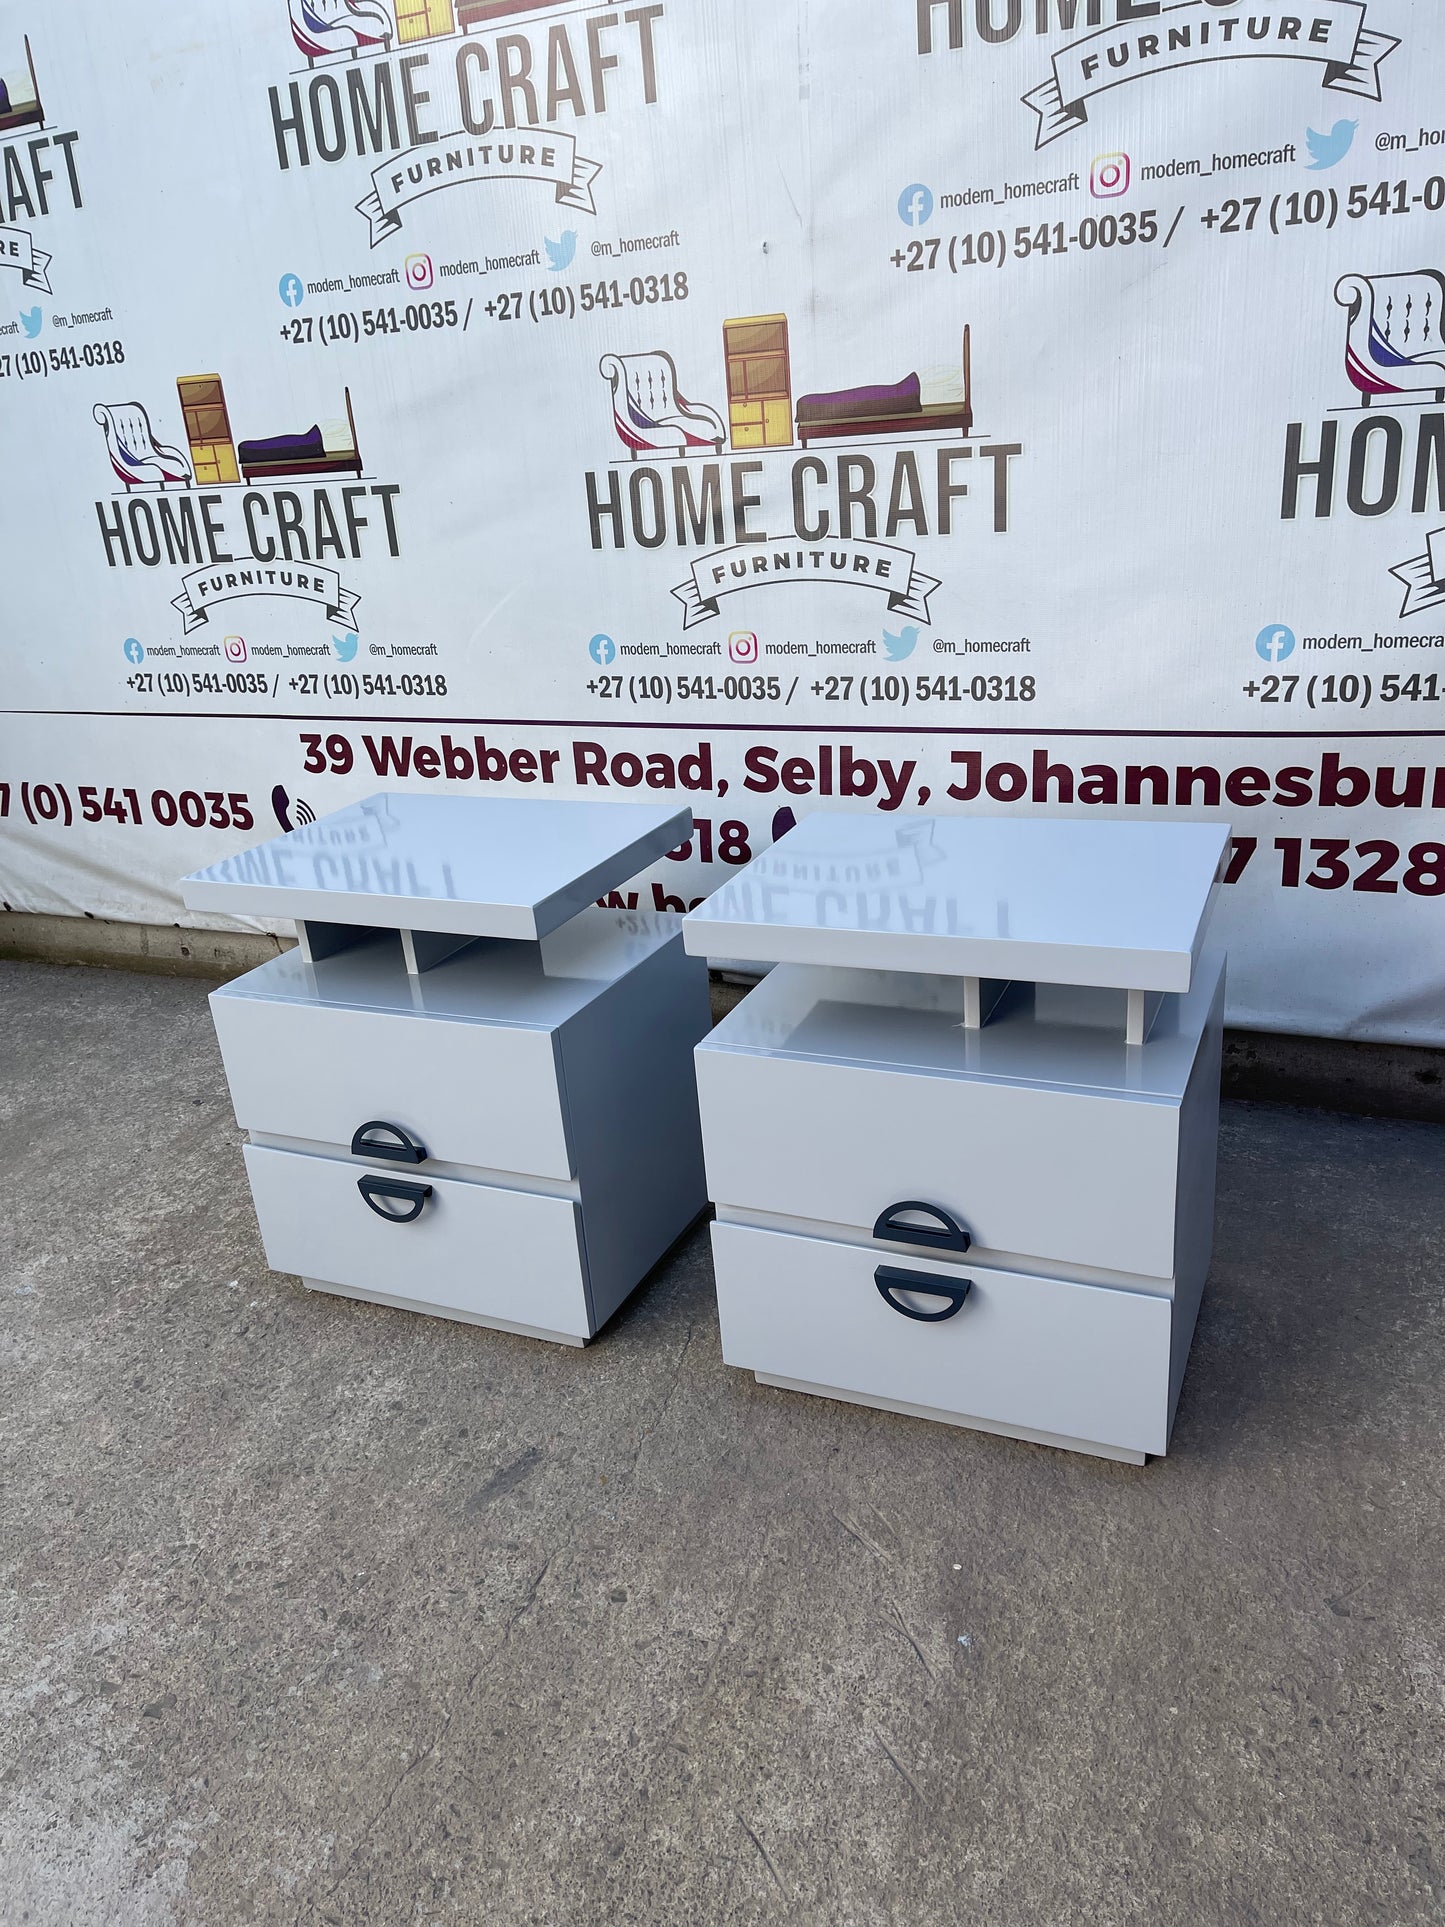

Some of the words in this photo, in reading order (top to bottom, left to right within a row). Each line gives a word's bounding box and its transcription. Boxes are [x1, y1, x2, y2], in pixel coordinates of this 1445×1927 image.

[1081, 16, 1333, 81] FURNITURE
[267, 53, 439, 170] HOME
[456, 3, 664, 136] CRAFT
[1375, 128, 1445, 152] @m_ho
[0, 130, 83, 224] AFT
[391, 144, 557, 193] FURNITURE
[591, 230, 680, 258] @m_homecraft
[949, 229, 1006, 274] (10)
[1014, 209, 1158, 259] 541-0035
[1269, 188, 1338, 235] (10)
[52, 307, 114, 329] @m_homecraft
[319, 312, 359, 347] (10)
[362, 299, 458, 336] 541-0035
[529, 286, 576, 323] (10)
[580, 271, 689, 312] 541-0318
[15, 350, 48, 380] (10)
[49, 340, 126, 372] 541-0318
[584, 460, 769, 550] HOME
[791, 442, 1023, 542] CRAFT
[95, 494, 234, 567] HOME
[242, 484, 401, 563] CRAFT
[197, 569, 325, 596] FURNITURE
[712, 551, 893, 585] FURNITURE
[369, 643, 438, 658] @m_homecraft
[933, 637, 1031, 656] @m_homecraft
[157, 673, 190, 697] (10)
[192, 673, 268, 694] 541-0035
[323, 673, 360, 699] (10)
[362, 674, 448, 696] 541-0318
[629, 675, 672, 704] (10)
[677, 675, 781, 700] 541-0035
[860, 676, 910, 706] (10)
[915, 675, 1036, 702] 541-0318
[1306, 675, 1372, 709] (10)
[299, 733, 354, 775] 39
[361, 735, 560, 784] Webber
[572, 741, 729, 798] Road,
[743, 745, 931, 811] Selby,
[21, 781, 73, 827] (0)
[78, 786, 143, 825] 541
[150, 789, 254, 831] 0035
[1274, 836, 1445, 897] 1328
